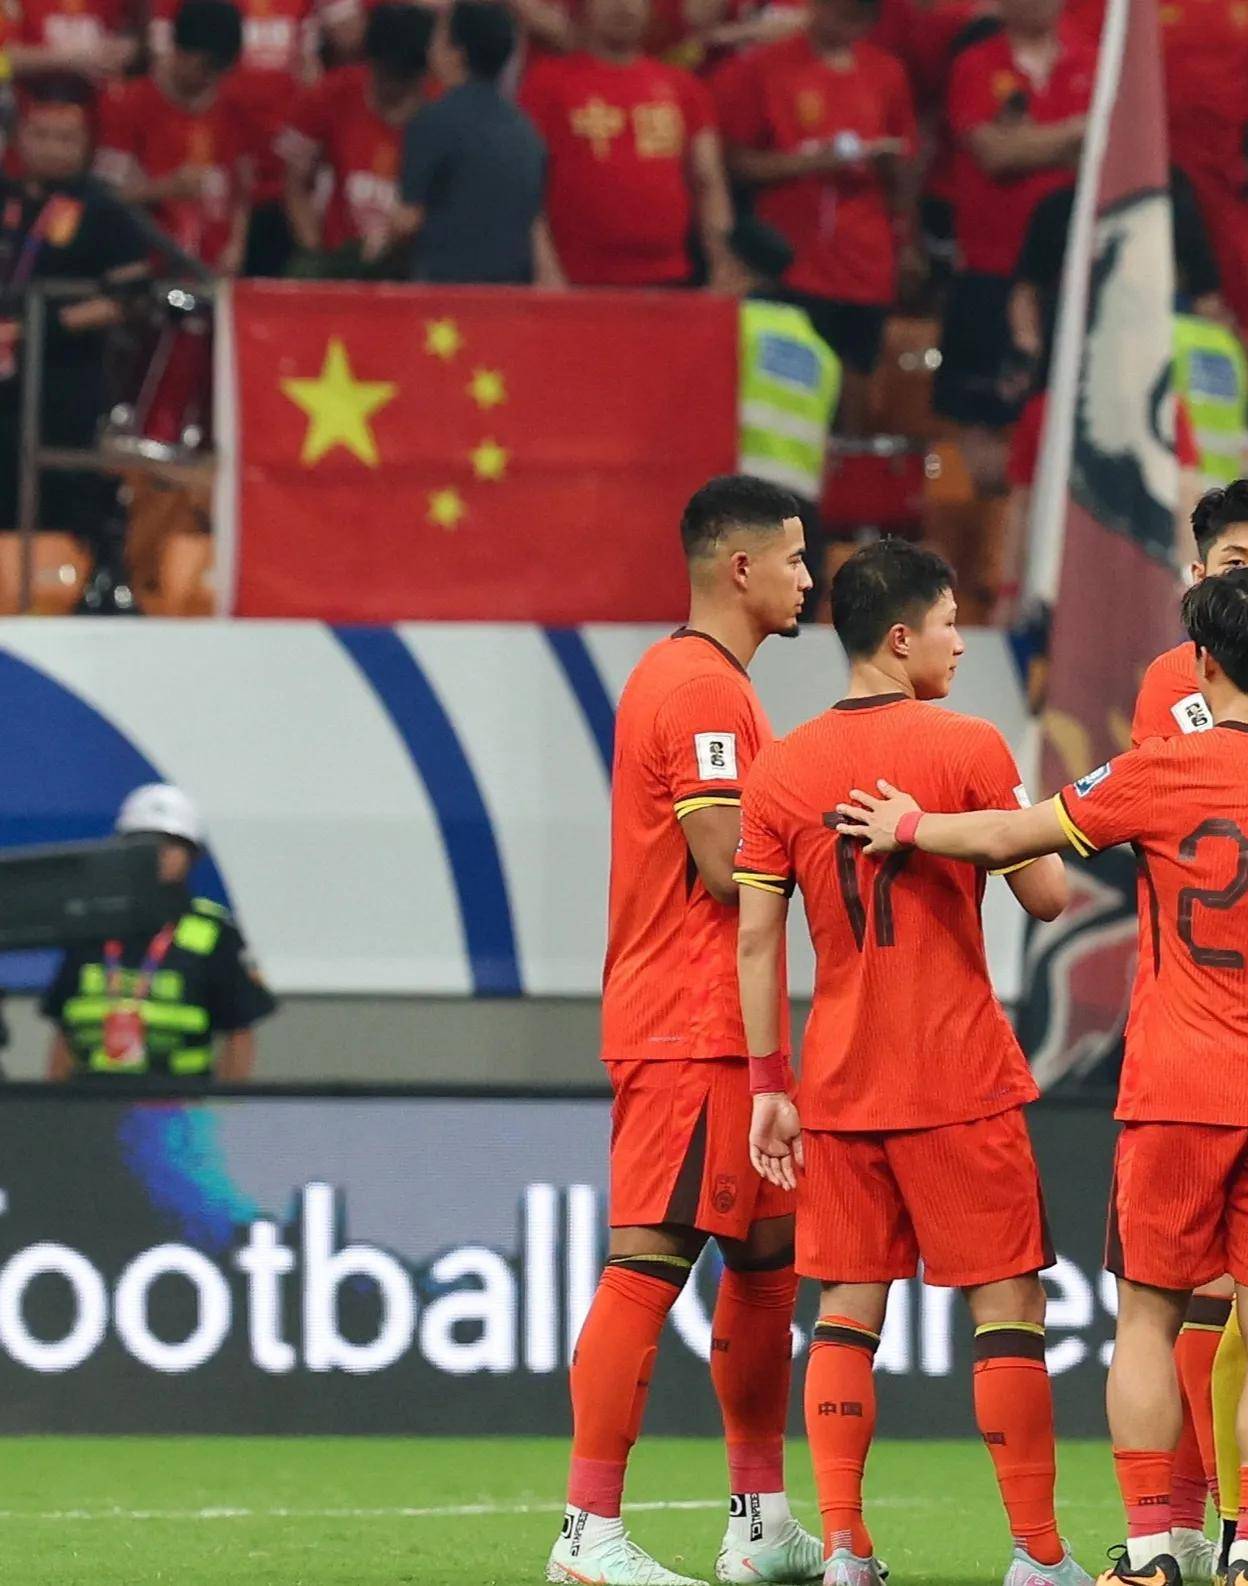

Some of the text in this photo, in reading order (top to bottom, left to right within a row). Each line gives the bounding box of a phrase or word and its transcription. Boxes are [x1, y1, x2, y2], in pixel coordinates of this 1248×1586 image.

[822, 811, 911, 951] 17
[0, 1182, 600, 1374] ootball
[817, 1401, 863, 1417] 中国
